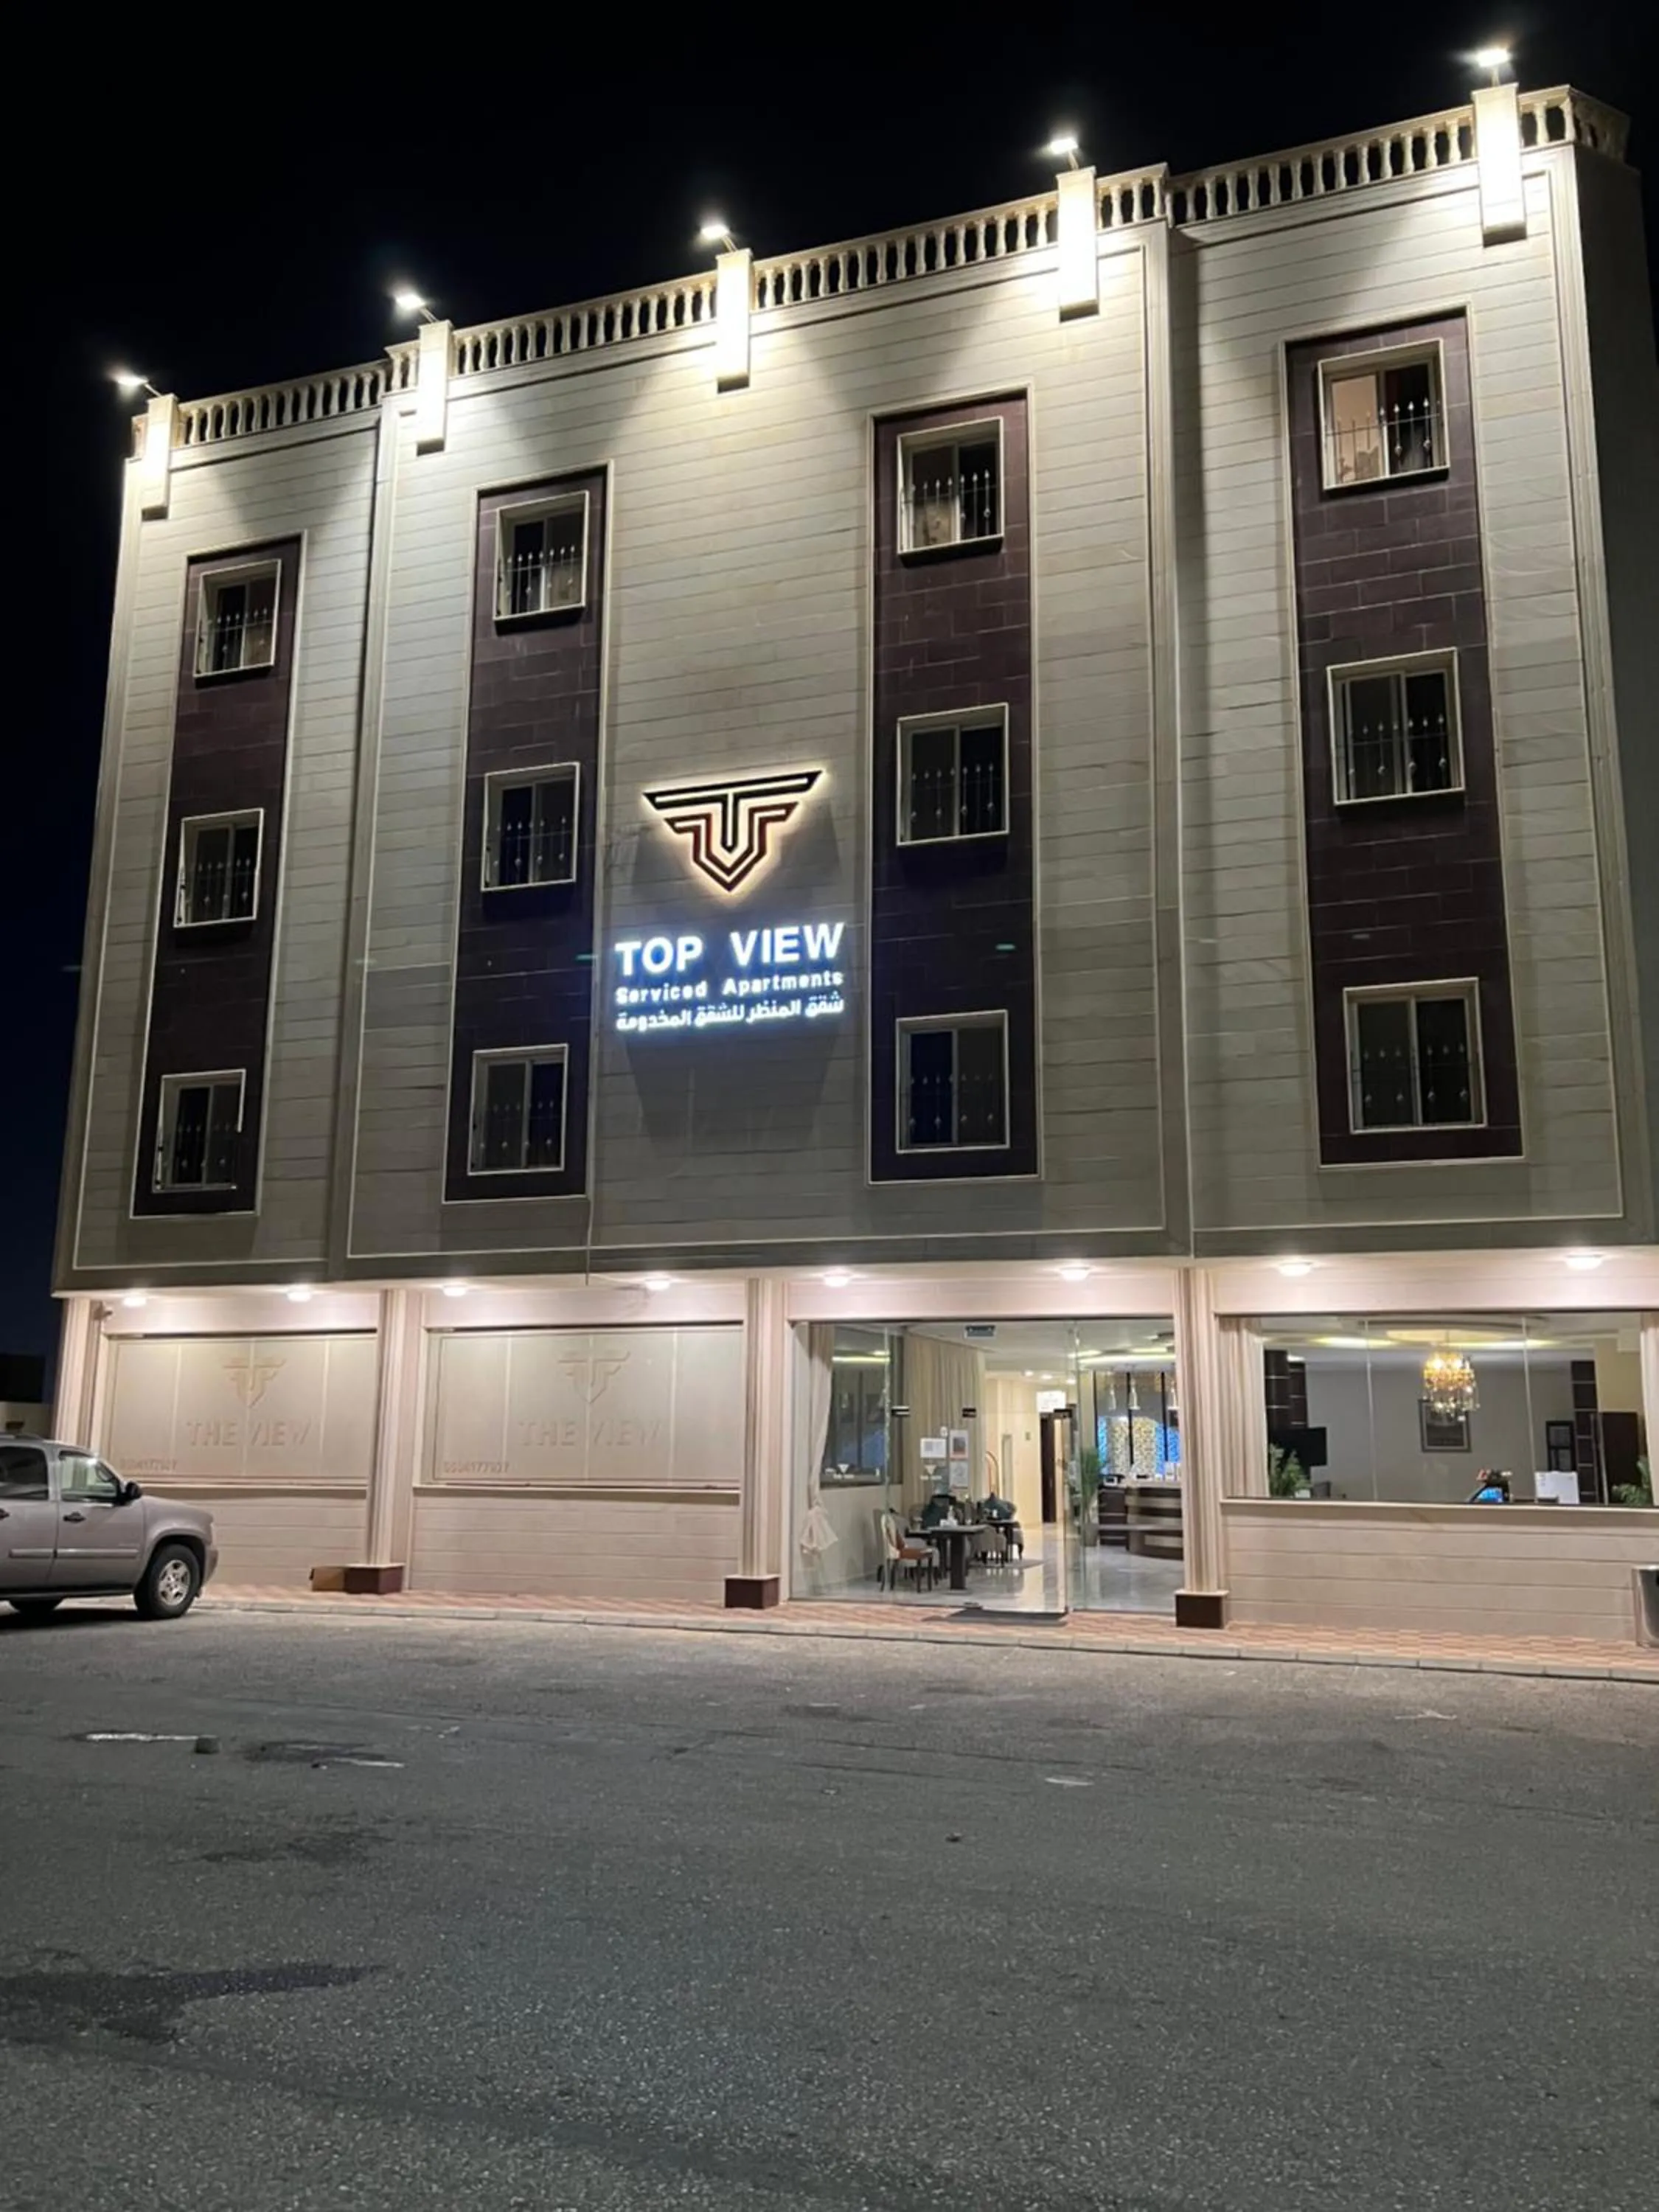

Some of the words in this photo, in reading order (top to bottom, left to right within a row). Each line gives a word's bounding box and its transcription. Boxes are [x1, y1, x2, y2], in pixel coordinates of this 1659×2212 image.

[614, 936, 704, 976] TOP
[729, 922, 845, 967] VIEW
[615, 980, 708, 1005] Serviced
[722, 970, 844, 996] Apartments
[694, 1001, 745, 1026] للشقق
[745, 998, 802, 1023] المنظر
[804, 991, 845, 1018] شقق
[616, 1009, 692, 1032] المخدومة
[187, 1420, 238, 1447] THE
[518, 1419, 576, 1447] THE
